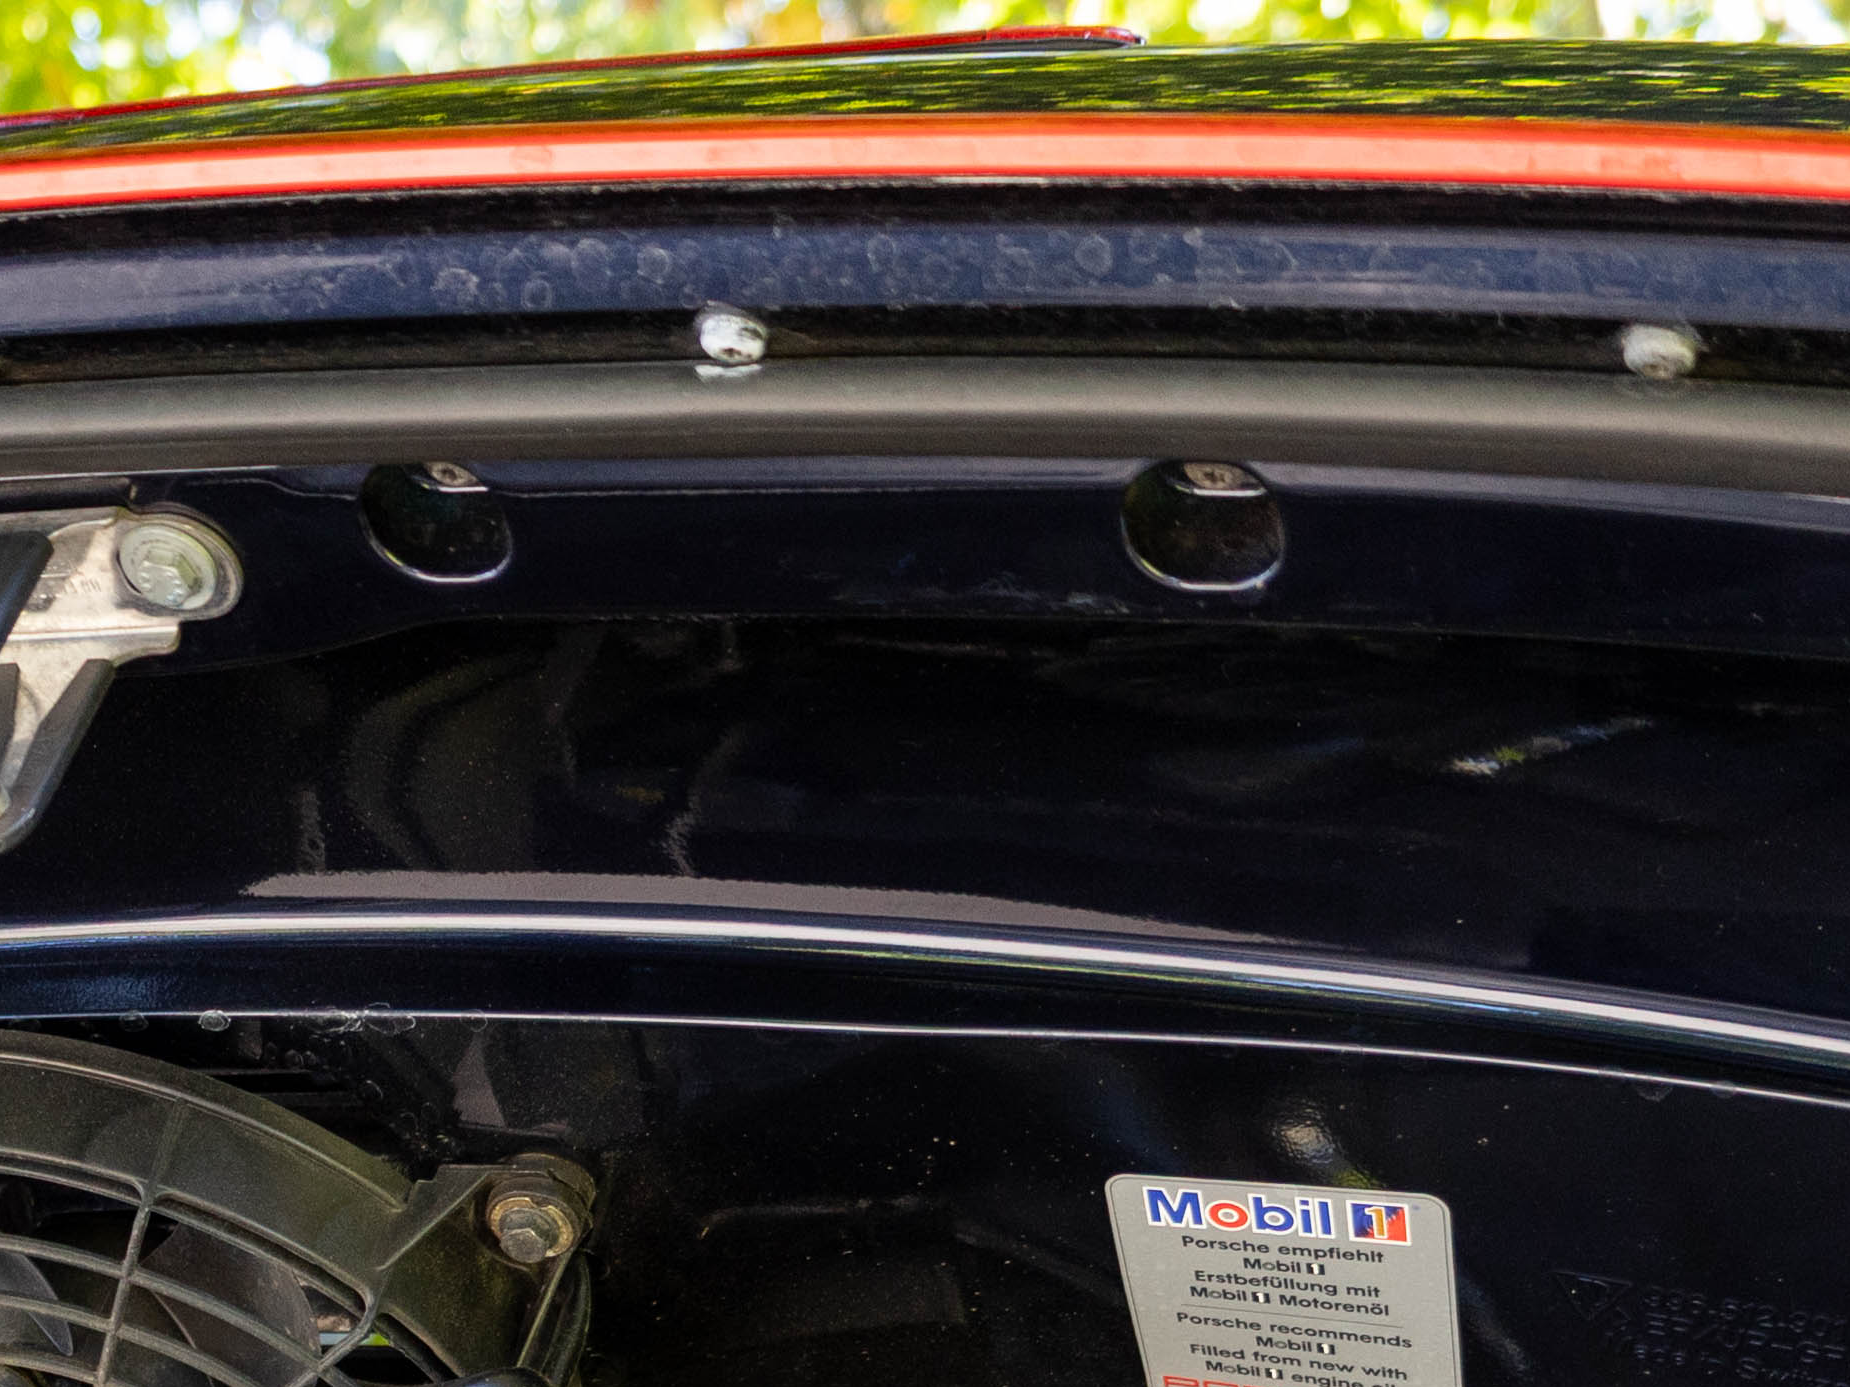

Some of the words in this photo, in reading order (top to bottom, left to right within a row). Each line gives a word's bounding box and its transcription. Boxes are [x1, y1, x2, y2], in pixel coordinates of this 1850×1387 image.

[1143, 1187, 1334, 1239] Mobil
[1181, 1236, 1270, 1255] Porsche
[1278, 1244, 1384, 1264] empfiehlt
[1244, 1257, 1301, 1274] Mobil
[1195, 1271, 1338, 1297] Erstbefüllung
[1346, 1285, 1381, 1299] mit
[1189, 1286, 1247, 1302] Mobil
[1279, 1295, 1390, 1316] Motorenöl
[1176, 1311, 1262, 1331] Porsche
[1269, 1322, 1413, 1349] recommends
[1256, 1335, 1312, 1352] Mobil
[1190, 1343, 1245, 1360] Filled
[1252, 1350, 1301, 1367] from
[1309, 1361, 1355, 1374] new
[1362, 1365, 1408, 1381] with
[1205, 1360, 1261, 1377] Mobil
